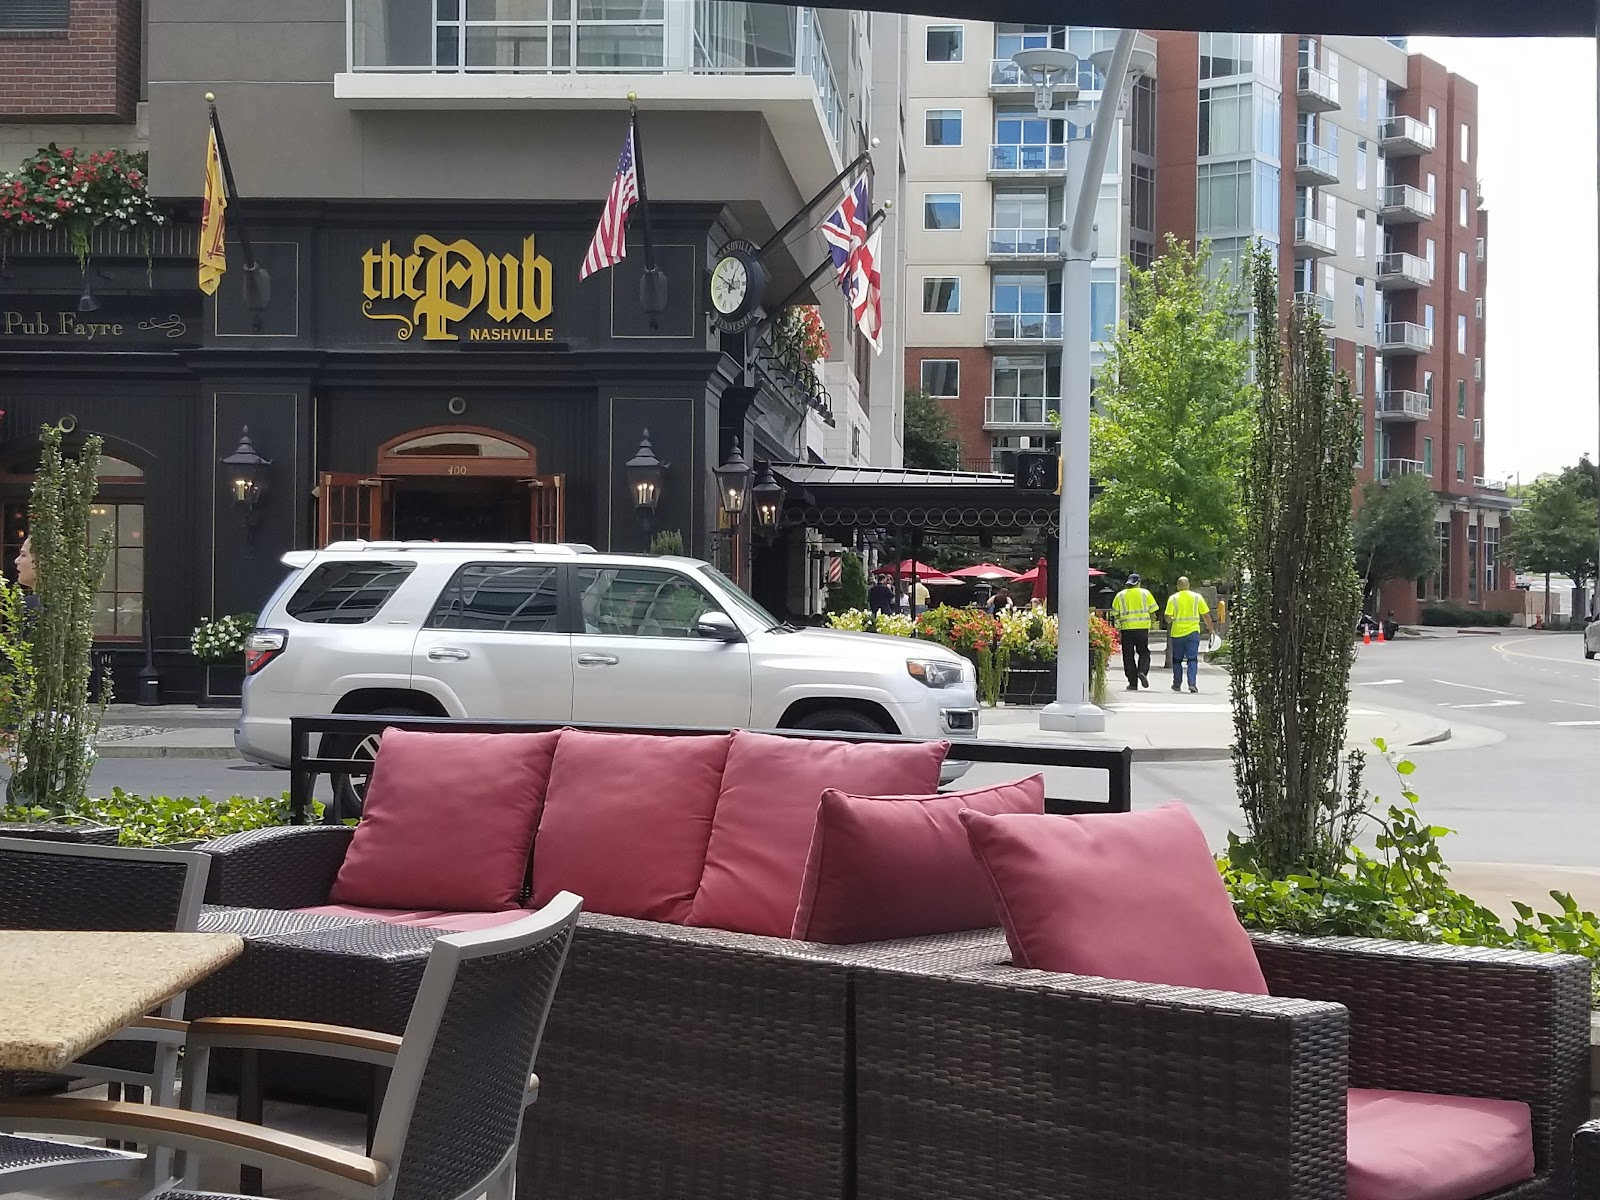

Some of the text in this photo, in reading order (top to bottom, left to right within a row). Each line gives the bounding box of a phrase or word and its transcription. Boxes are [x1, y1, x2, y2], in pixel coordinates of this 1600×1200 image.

[361, 232, 554, 342] the Pub
[3, 311, 124, 341] Pub Fayre
[469, 328, 554, 341] NASHVILLE
[447, 465, 467, 476] 400
